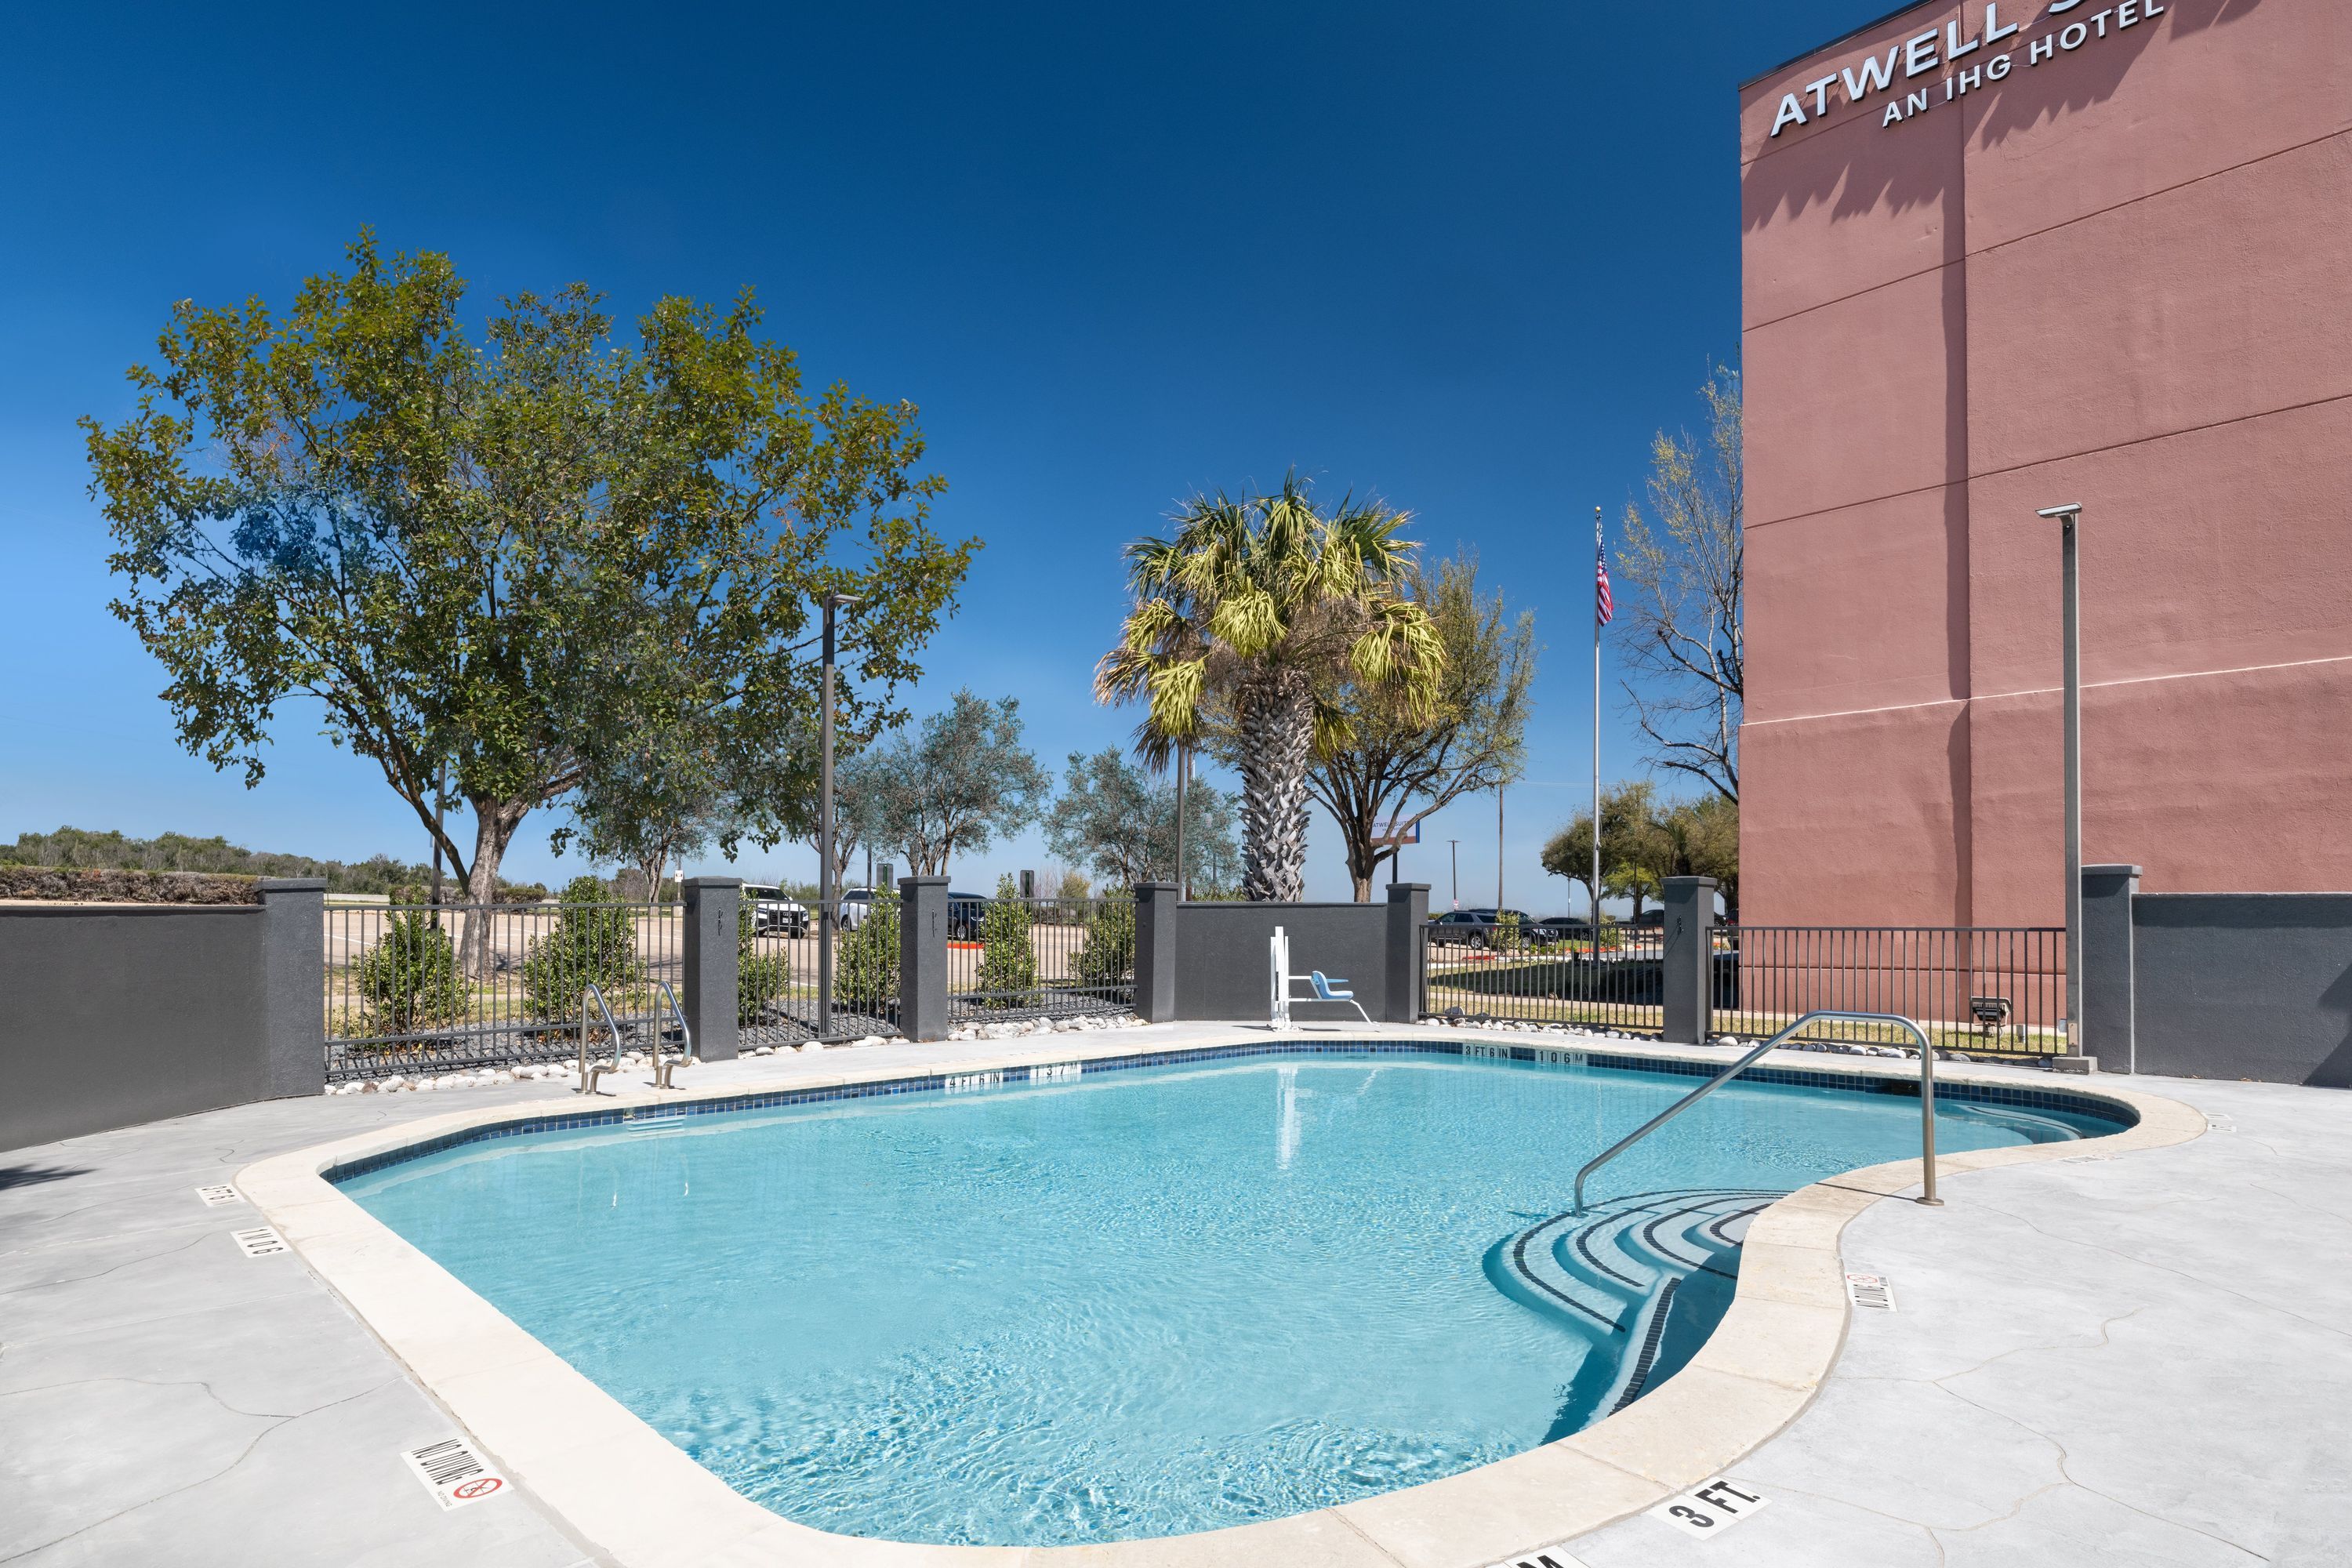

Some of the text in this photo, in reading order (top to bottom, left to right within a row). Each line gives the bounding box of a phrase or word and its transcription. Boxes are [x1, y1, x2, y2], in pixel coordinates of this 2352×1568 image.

[1769, 2, 2020, 138] ATWELL
[1882, 0, 2165, 129] AN IHG HOTEL
[1465, 1045, 1472, 1055] 3
[1490, 1047, 1495, 1058] 6
[949, 1076, 956, 1087] 4
[961, 1074, 973, 1087] FT
[989, 1071, 1000, 1083] IN
[410, 1439, 485, 1486] NO DIVING
[1668, 1505, 1715, 1528] 3
